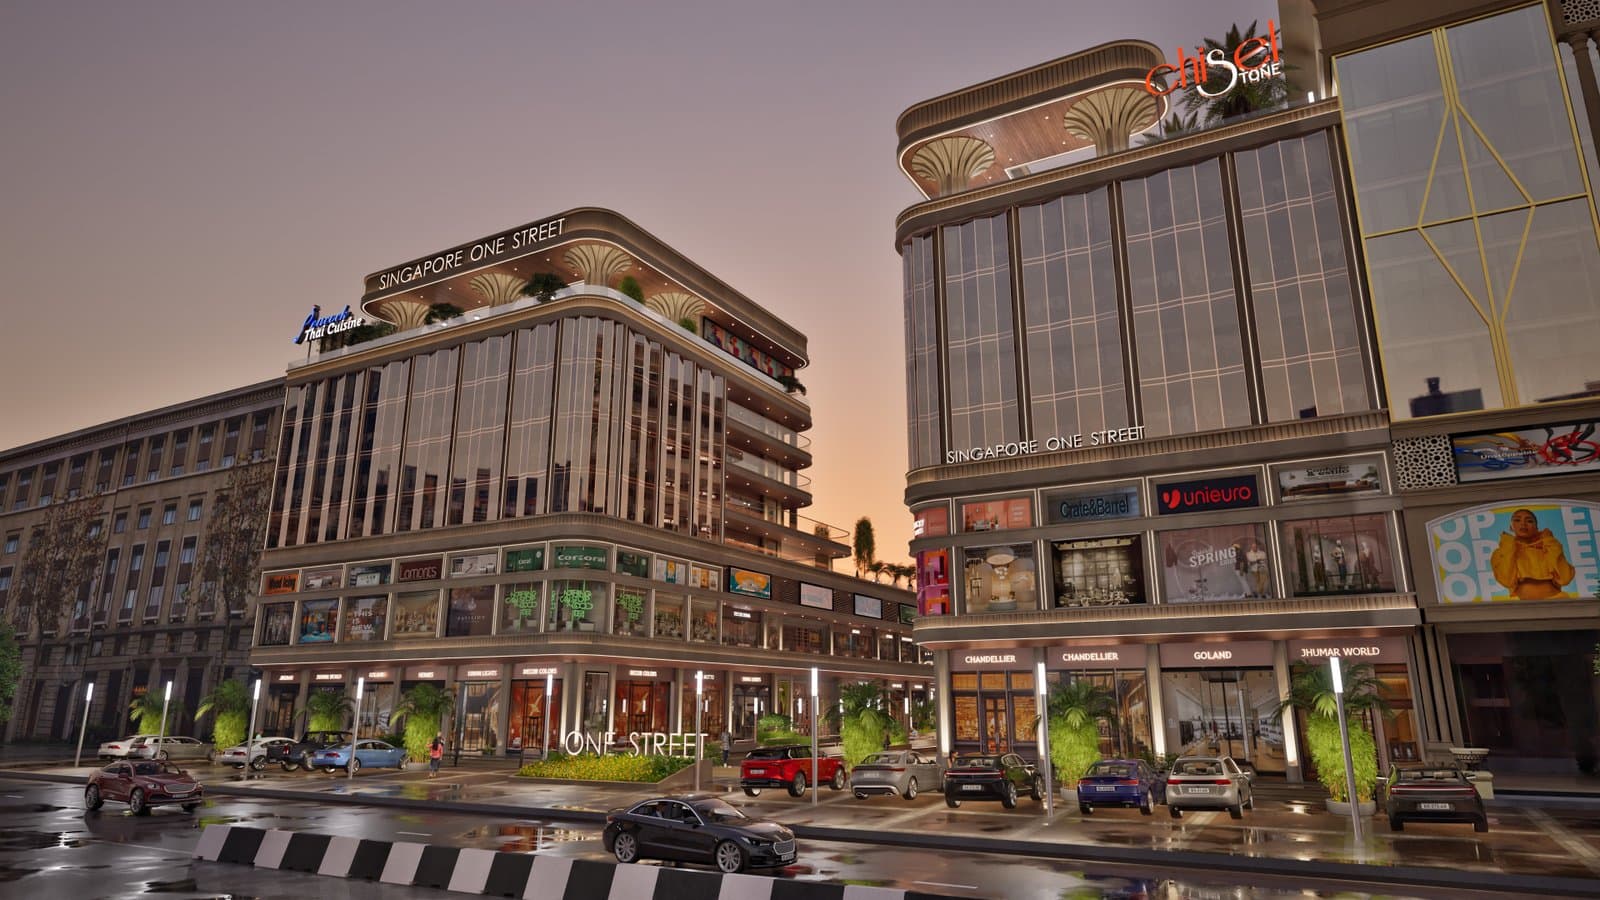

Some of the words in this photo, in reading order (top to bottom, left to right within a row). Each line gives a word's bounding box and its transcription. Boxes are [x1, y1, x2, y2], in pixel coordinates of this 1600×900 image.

[378, 249, 464, 291] SINGAPORE
[470, 237, 505, 261] ONE
[512, 217, 565, 249] STREET
[304, 325, 325, 341] Thai
[327, 317, 362, 335] Cuisine
[946, 440, 1038, 464] SINGAPORE
[1046, 434, 1083, 451] ONE
[1090, 425, 1145, 445] STREET
[1060, 493, 1129, 518] Crate&Barrel
[1183, 485, 1251, 507] unieuro
[1189, 547, 1237, 568] SPRING
[964, 655, 1017, 664] CHANDELLIER
[1062, 652, 1119, 662] CHANDELLIER
[1193, 651, 1232, 660] GOLAND
[1301, 648, 1341, 658] JHUMAR
[1343, 646, 1380, 656] WORLD
[565, 731, 616, 756] ONE
[629, 731, 709, 761] STREET
